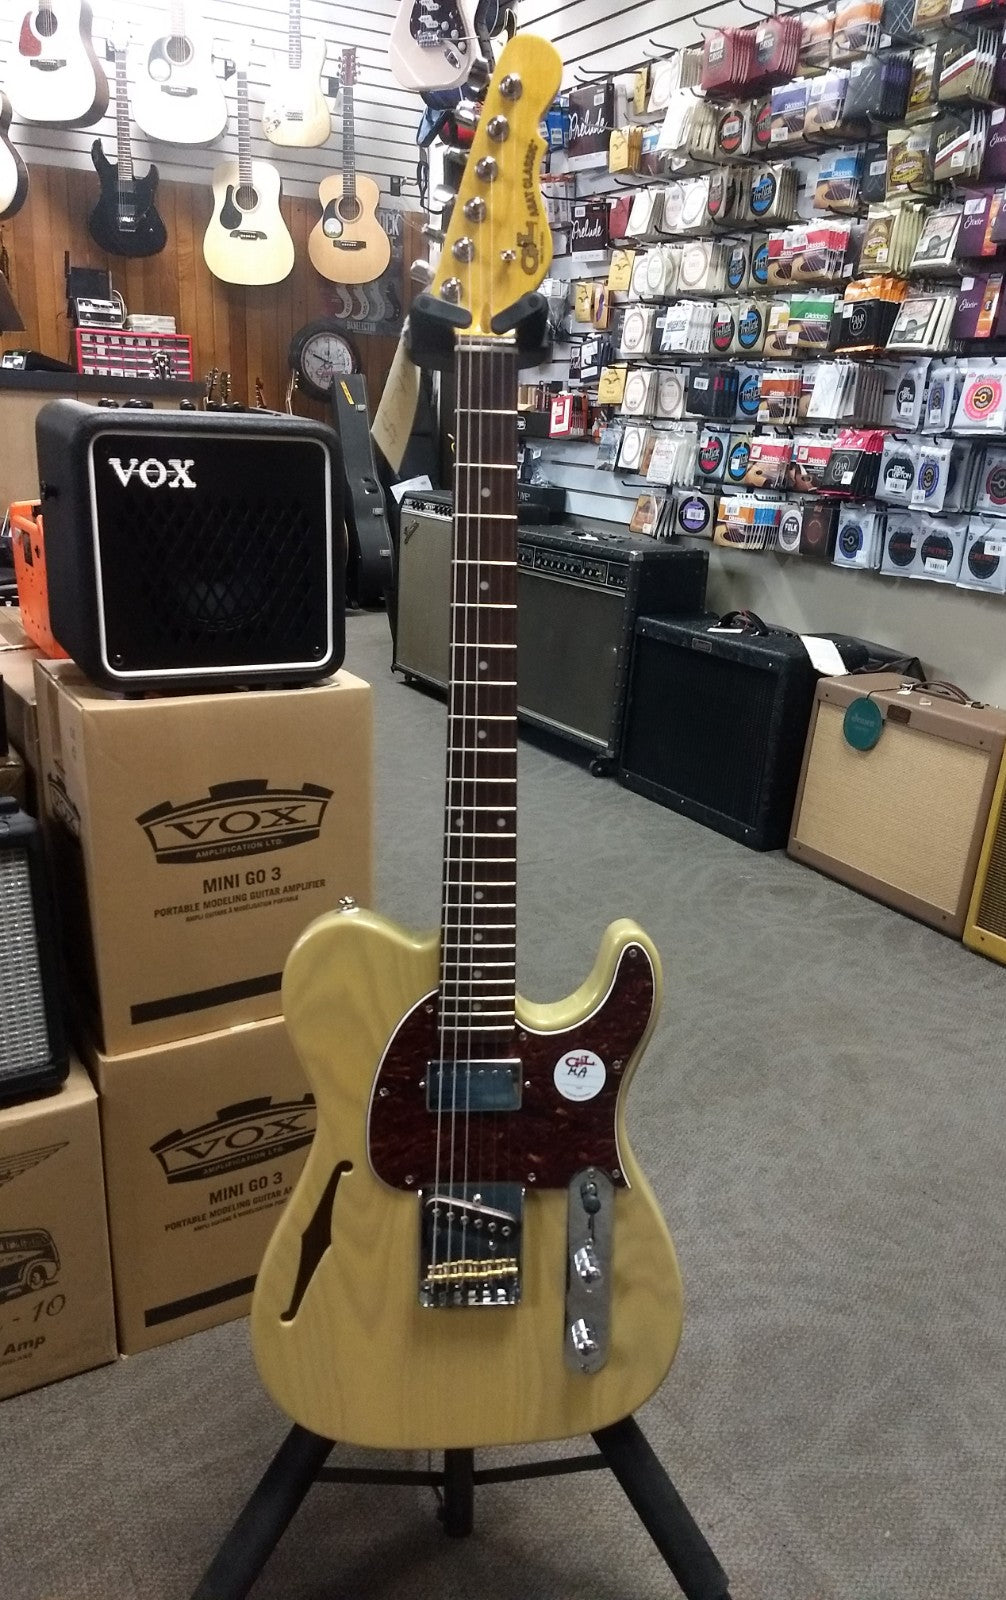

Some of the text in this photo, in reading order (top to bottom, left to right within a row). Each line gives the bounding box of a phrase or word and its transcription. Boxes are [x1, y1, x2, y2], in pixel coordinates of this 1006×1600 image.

[568, 107, 608, 141] Prelude
[571, 218, 604, 240] Prelude
[108, 457, 197, 489] VOX
[165, 805, 306, 840] VOX
[195, 838, 284, 859] AMPLIFICATION LTD.
[203, 867, 282, 894] MINI GO 3
[154, 878, 326, 918] PORTABLE MODELING GUITAR AMPLIFIER
[176, 1113, 307, 1159] VOX
[203, 1151, 266, 1175] AMPLIFICATION
[209, 1171, 283, 1205] MINI GO 3
[164, 1212, 207, 1232] PORTABLE
[209, 1201, 251, 1218] MODELING
[253, 1192, 282, 1206] GUITAR
[33, 1294, 66, 1322] 10
[3, 1334, 46, 1356] Amp
